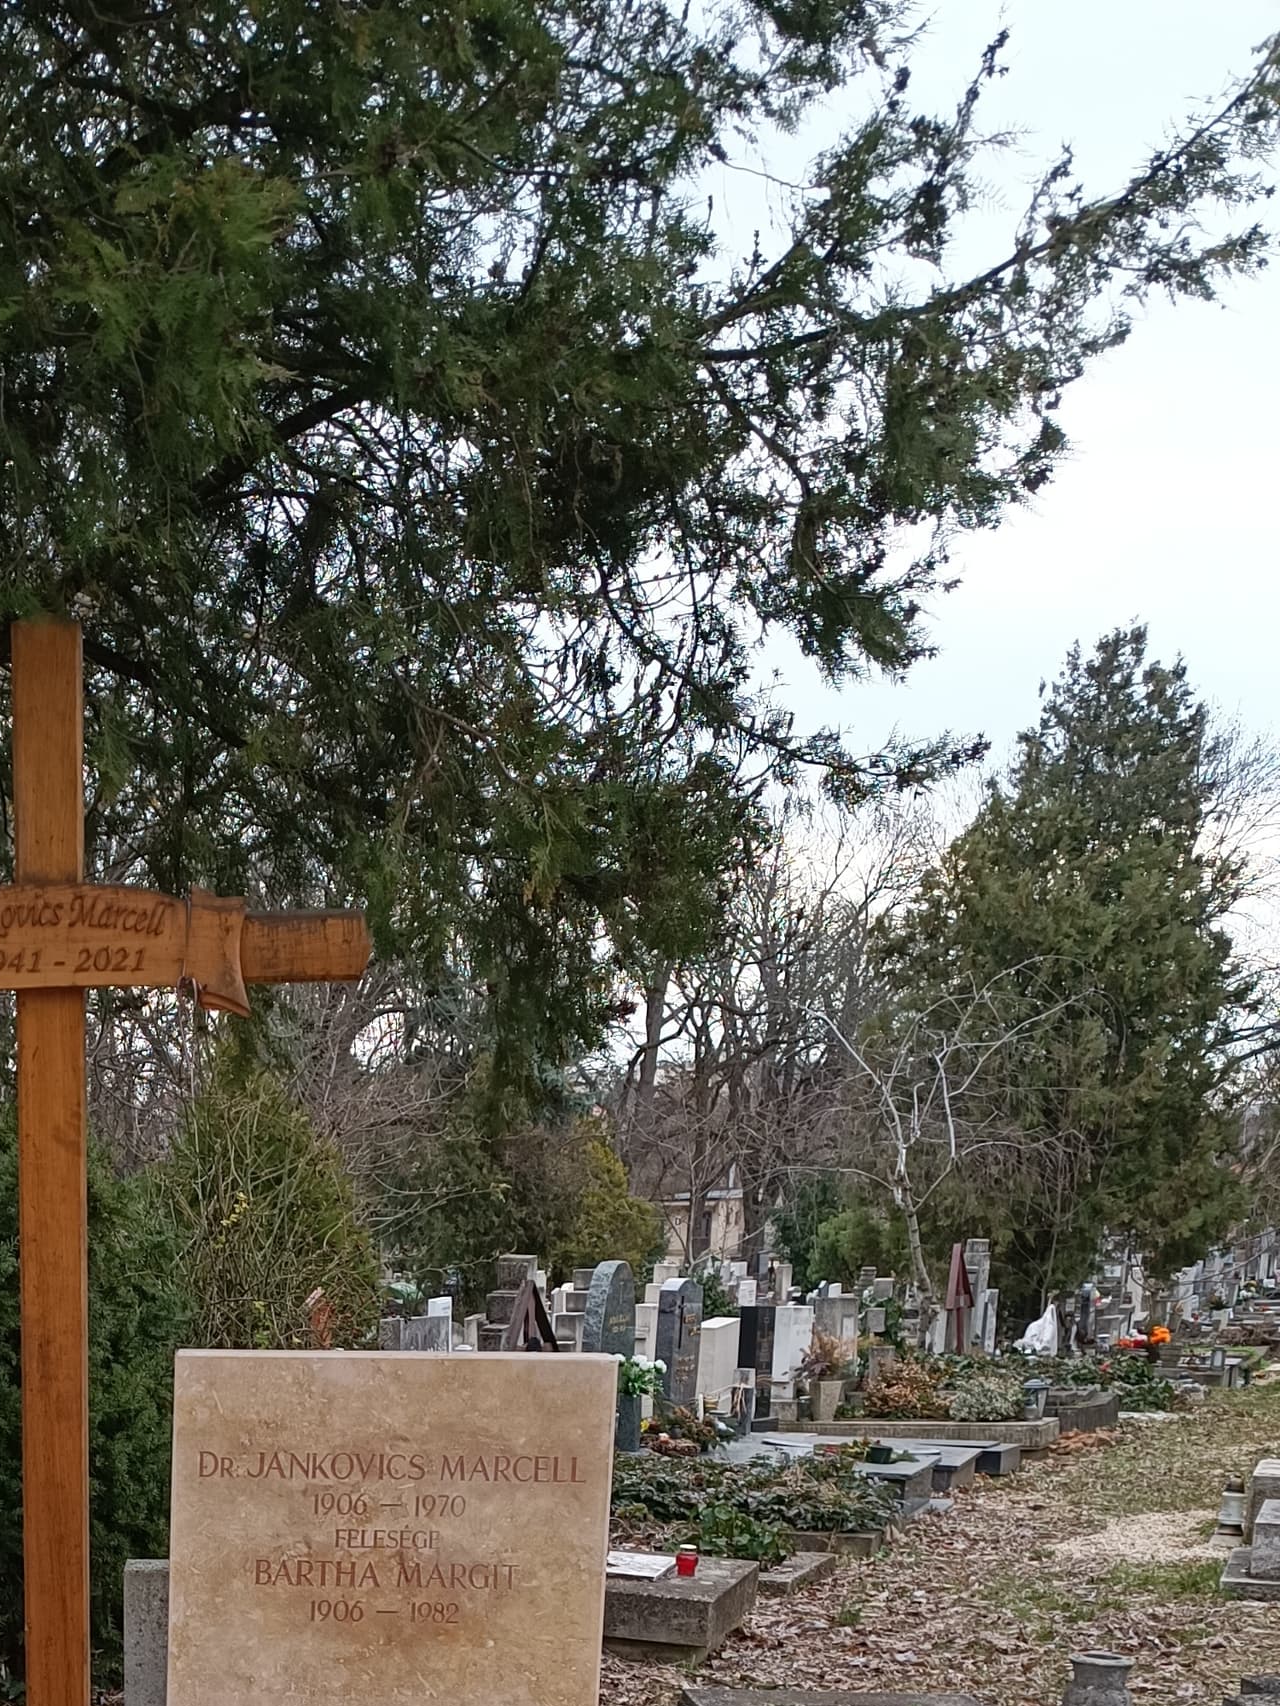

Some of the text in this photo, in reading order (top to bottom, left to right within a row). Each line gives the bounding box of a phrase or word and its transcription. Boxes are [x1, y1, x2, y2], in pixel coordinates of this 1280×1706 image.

[68, 894, 175, 936] Marcell
[73, 945, 145, 974] 2021
[246, 1452, 425, 1480] JANKOVICS
[440, 1455, 587, 1483] MARCELL
[313, 1493, 368, 1516] 1906
[414, 1495, 466, 1518] 1970
[335, 1524, 440, 1549] FELESÉGE
[255, 1559, 520, 1590] BARTHA MARGIT
[310, 1599, 364, 1622] 1906
[409, 1601, 460, 1624] 1982
